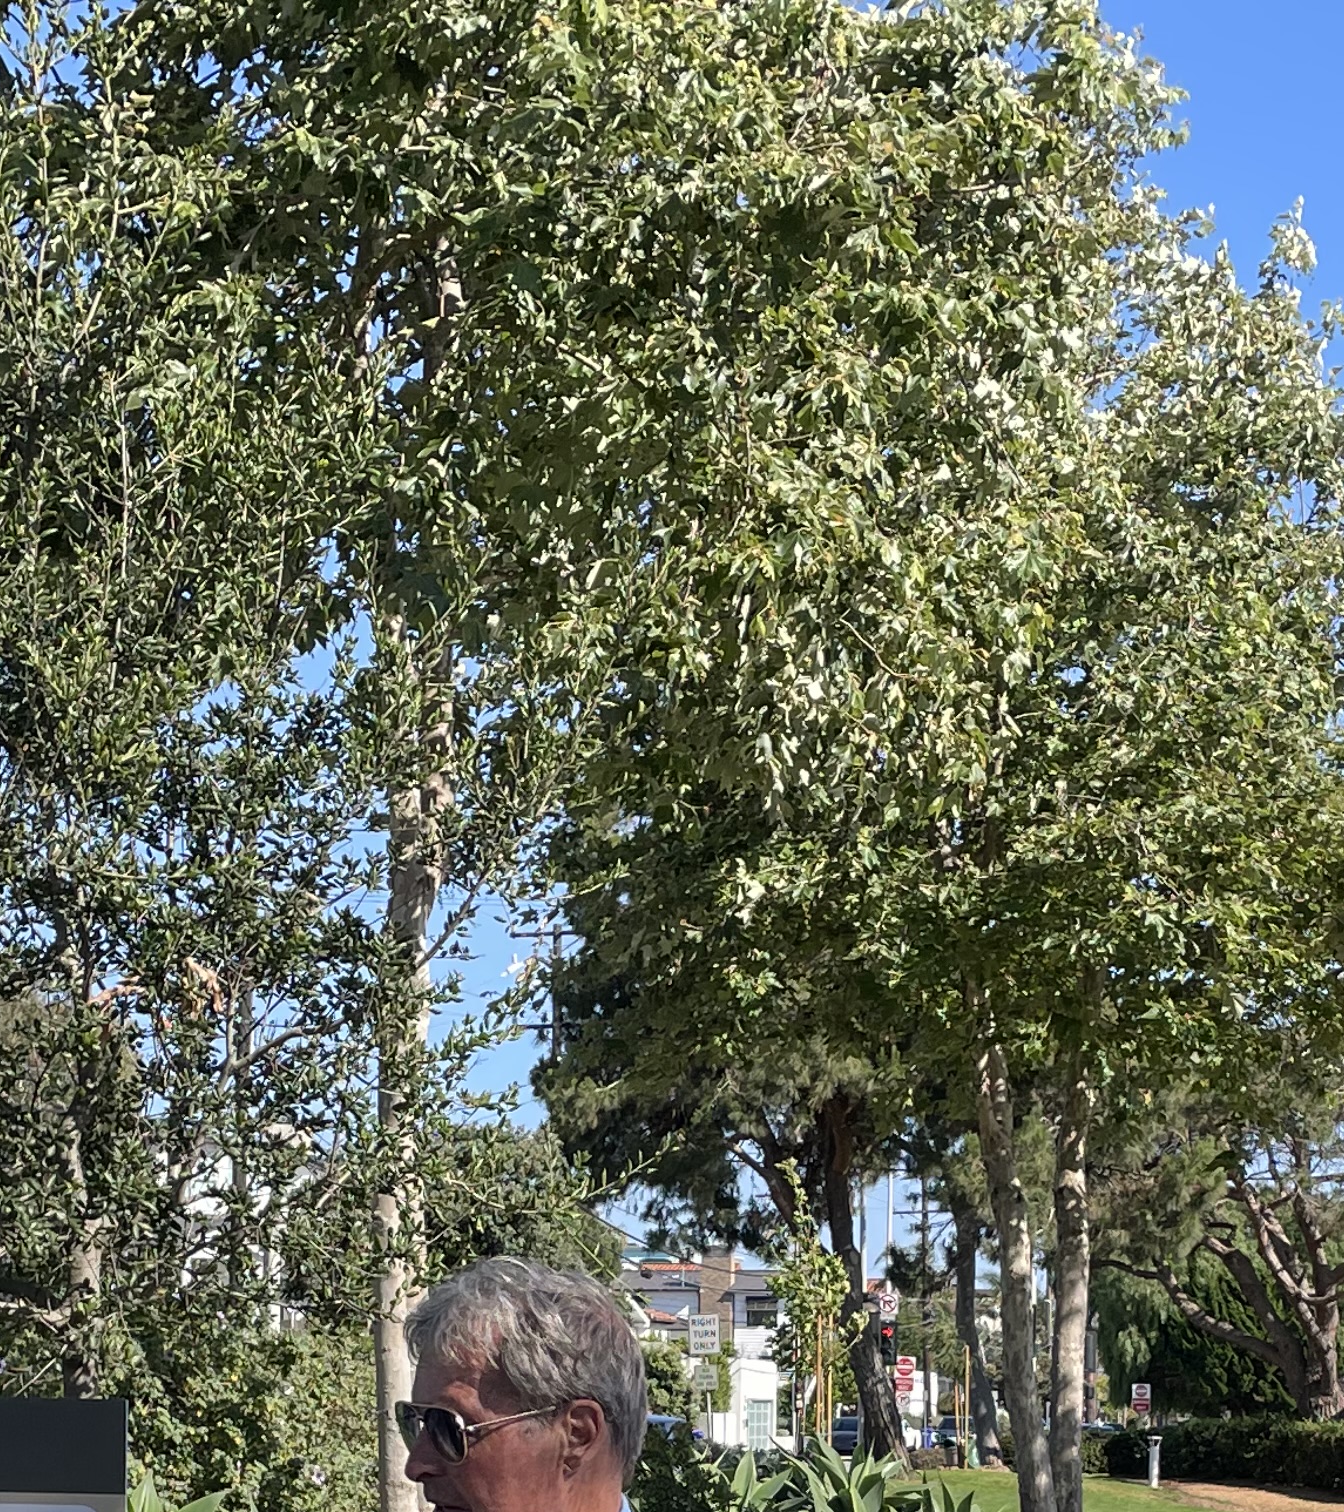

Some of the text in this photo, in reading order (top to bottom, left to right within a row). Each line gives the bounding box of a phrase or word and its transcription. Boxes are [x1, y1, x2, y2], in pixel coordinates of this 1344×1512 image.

[691, 1317, 716, 1327] RIGHT
[693, 1329, 716, 1339] TURN
[693, 1341, 716, 1351] ONLY
